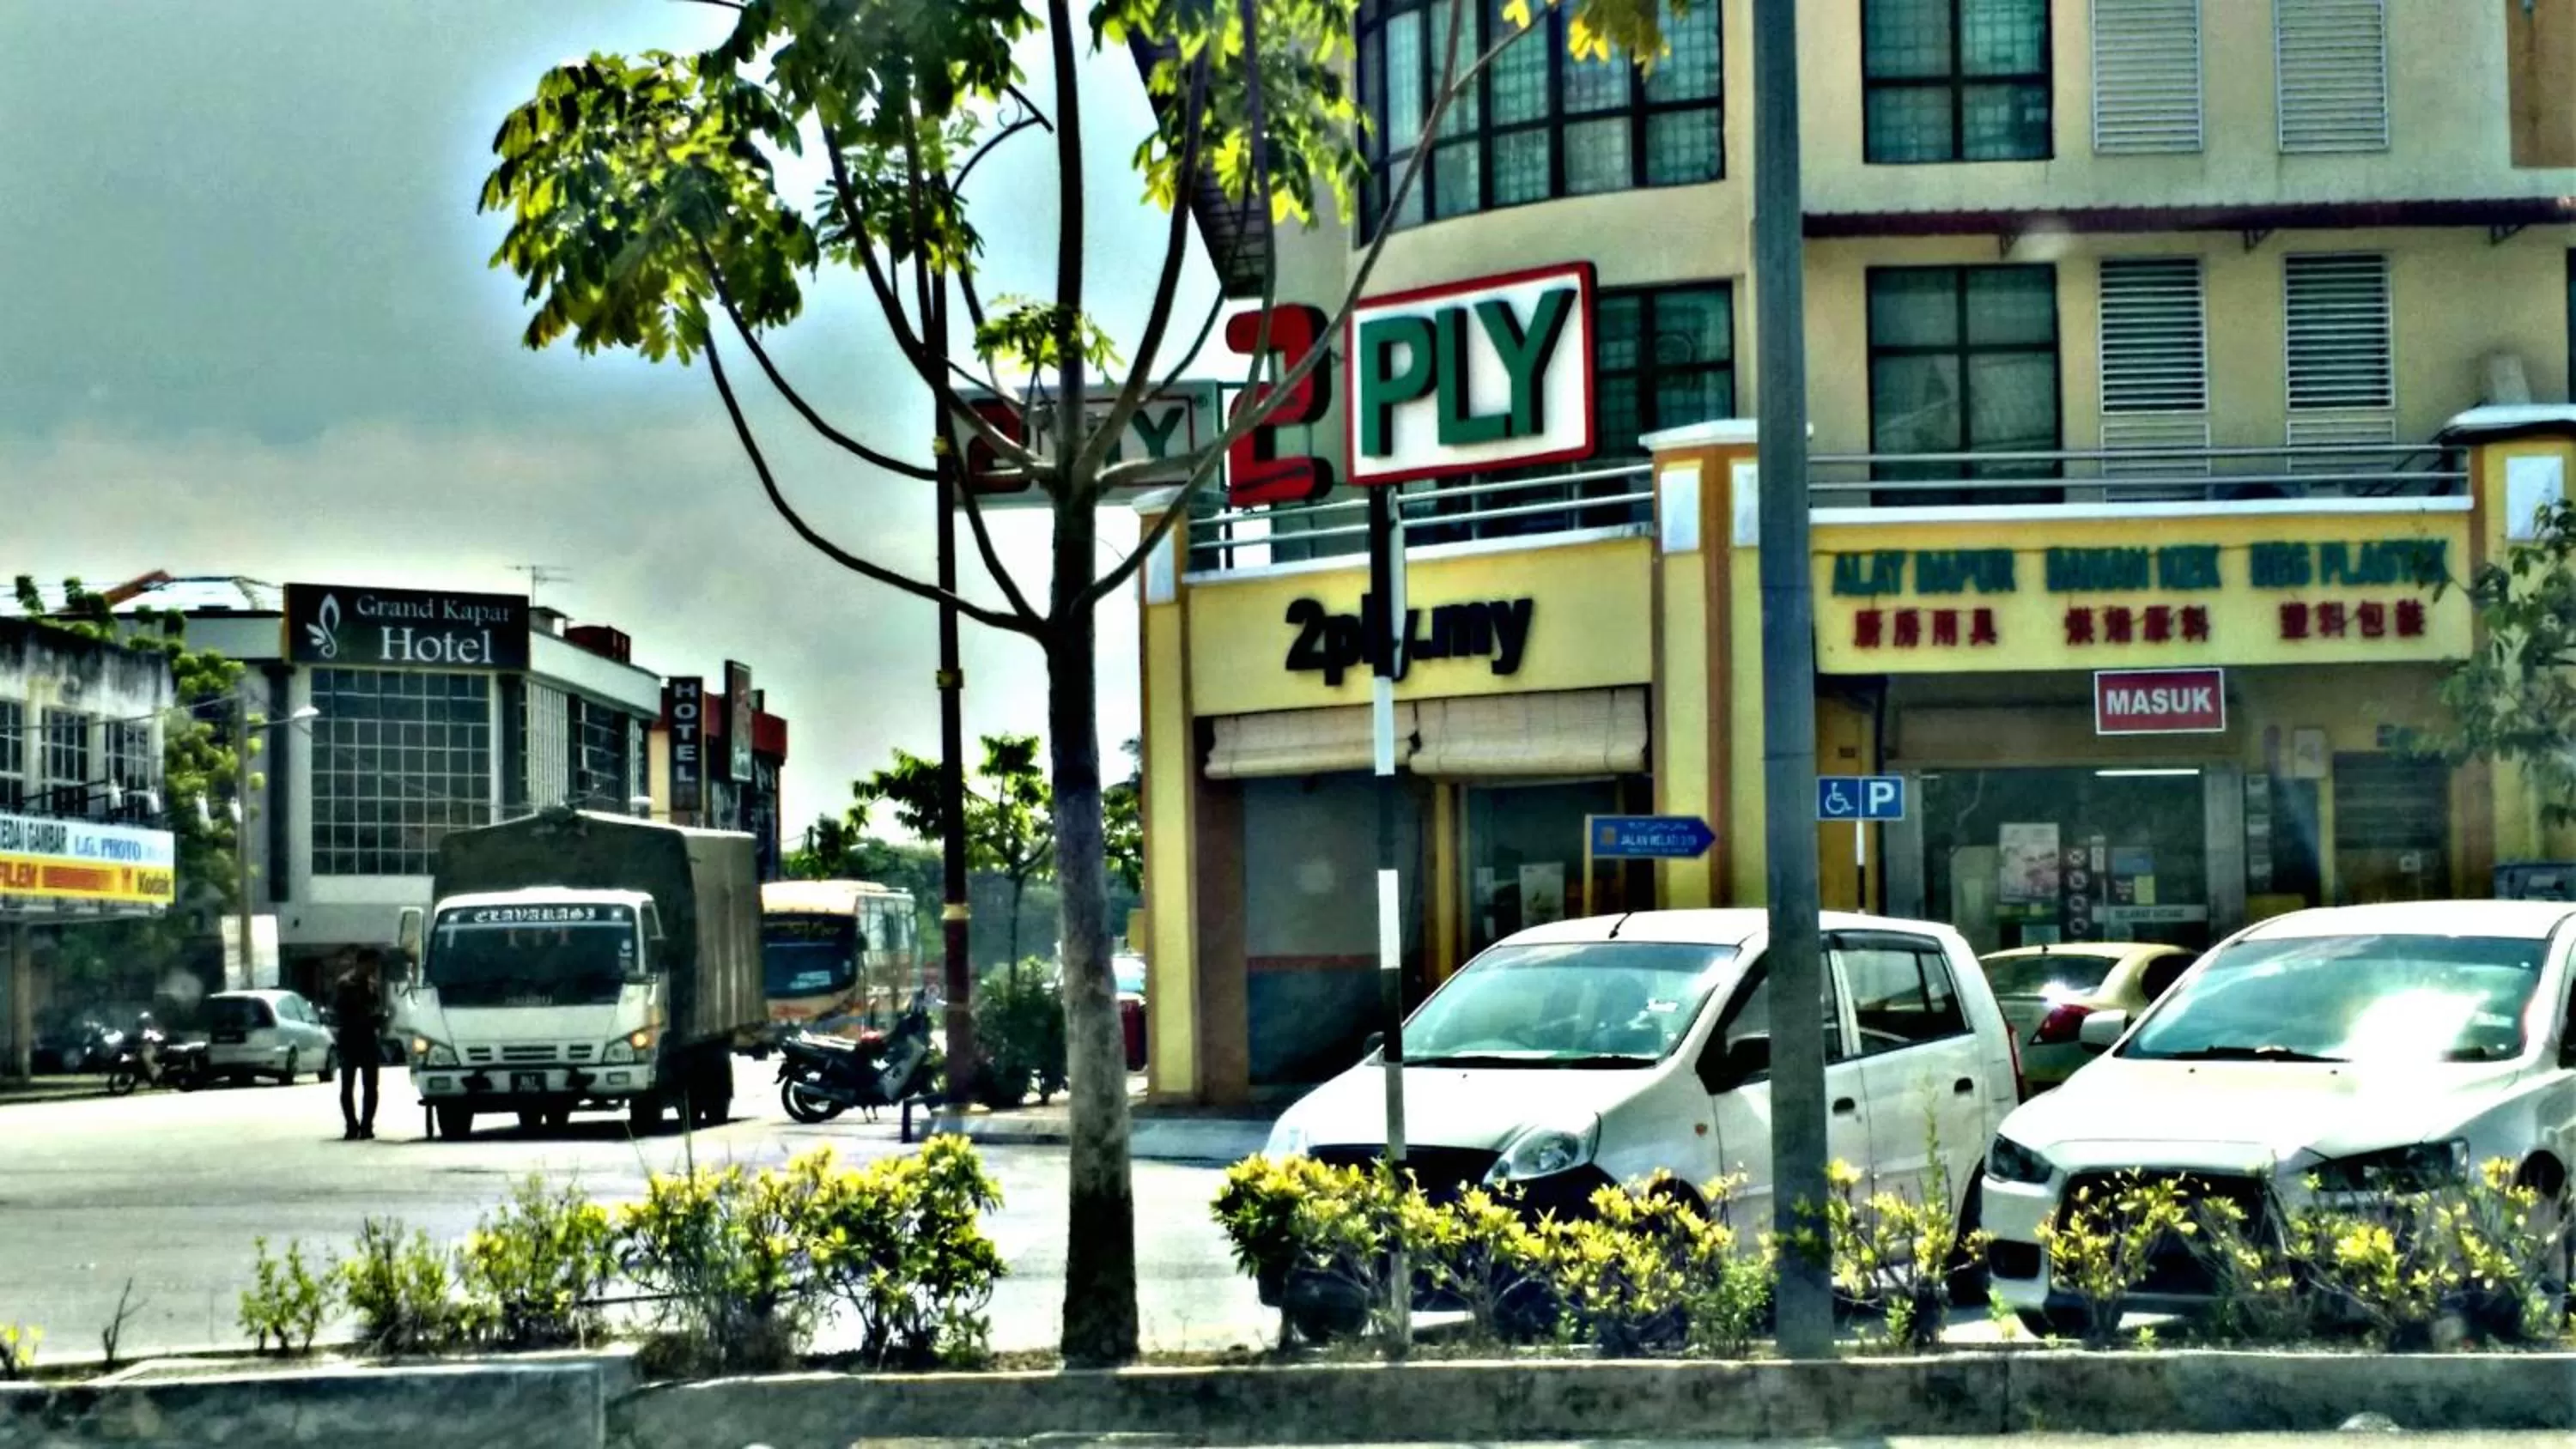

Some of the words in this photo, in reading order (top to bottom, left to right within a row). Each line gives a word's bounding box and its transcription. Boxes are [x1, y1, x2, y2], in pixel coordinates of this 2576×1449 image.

[1225, 303, 1333, 506] 2
[1359, 288, 1577, 458] PLY
[356, 594, 434, 619] Grand
[442, 598, 511, 627] Kapar
[379, 626, 495, 664] Hotel
[2105, 687, 2213, 715] MASUK
[674, 683, 697, 782] HOTEL
[1869, 781, 1896, 815] P
[0, 820, 25, 852] EDAI
[137, 869, 171, 895] Kodak
